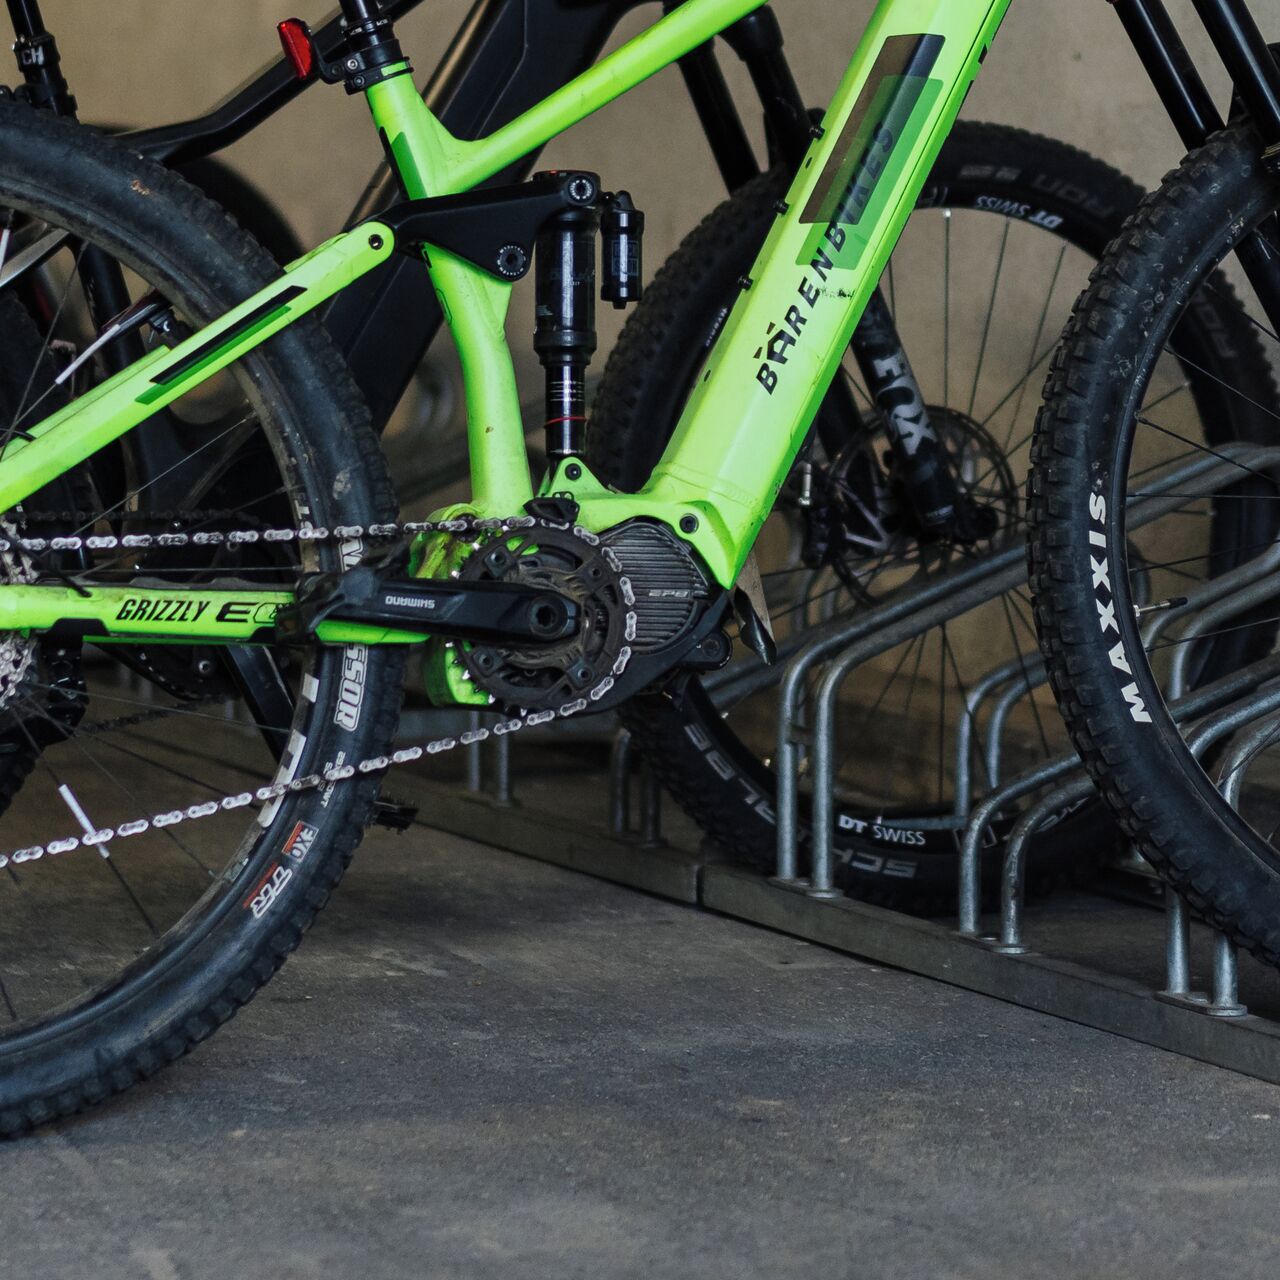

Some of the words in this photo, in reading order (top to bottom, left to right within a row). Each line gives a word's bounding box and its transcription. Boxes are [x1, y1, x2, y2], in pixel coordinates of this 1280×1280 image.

[974, 194, 1032, 219] SWISS
[1029, 208, 1065, 230] DT
[753, 121, 895, 396] BÄRENBIKES
[871, 346, 939, 456] FOX
[116, 599, 210, 622] GRIZZLY
[385, 594, 436, 611] SHIMANO
[1087, 492, 1153, 724] MAXXIS
[837, 813, 869, 834] DT
[871, 822, 927, 847] SWISS
